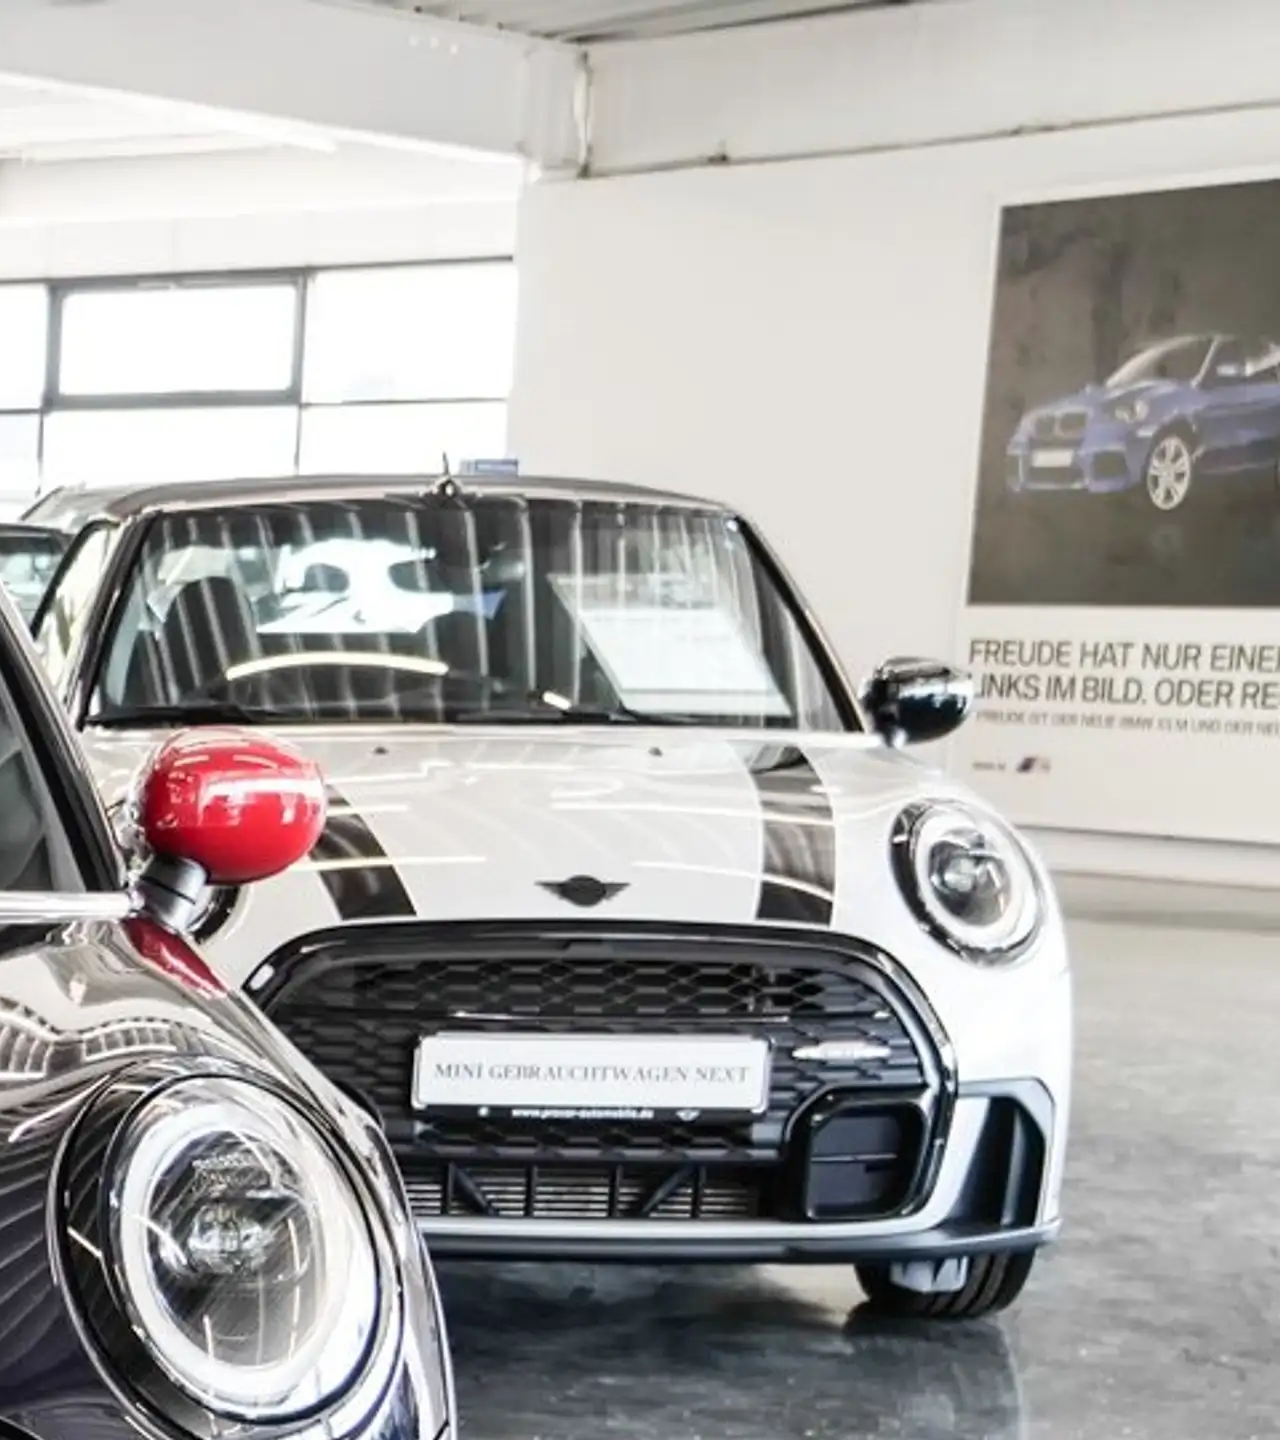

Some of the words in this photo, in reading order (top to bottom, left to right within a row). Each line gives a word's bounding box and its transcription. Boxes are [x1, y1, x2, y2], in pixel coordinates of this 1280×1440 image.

[968, 638, 1073, 668] FREUDE
[1079, 641, 1135, 669] HAT
[1141, 642, 1203, 671] NUR
[974, 672, 1041, 701] INKS
[1044, 674, 1077, 702] IM
[1081, 675, 1147, 705] BILD.
[1154, 677, 1235, 708] ODER
[435, 1063, 483, 1080] MINI
[487, 1064, 687, 1082] GEBRAUCHTWAGEN
[695, 1066, 751, 1083] NEXT
